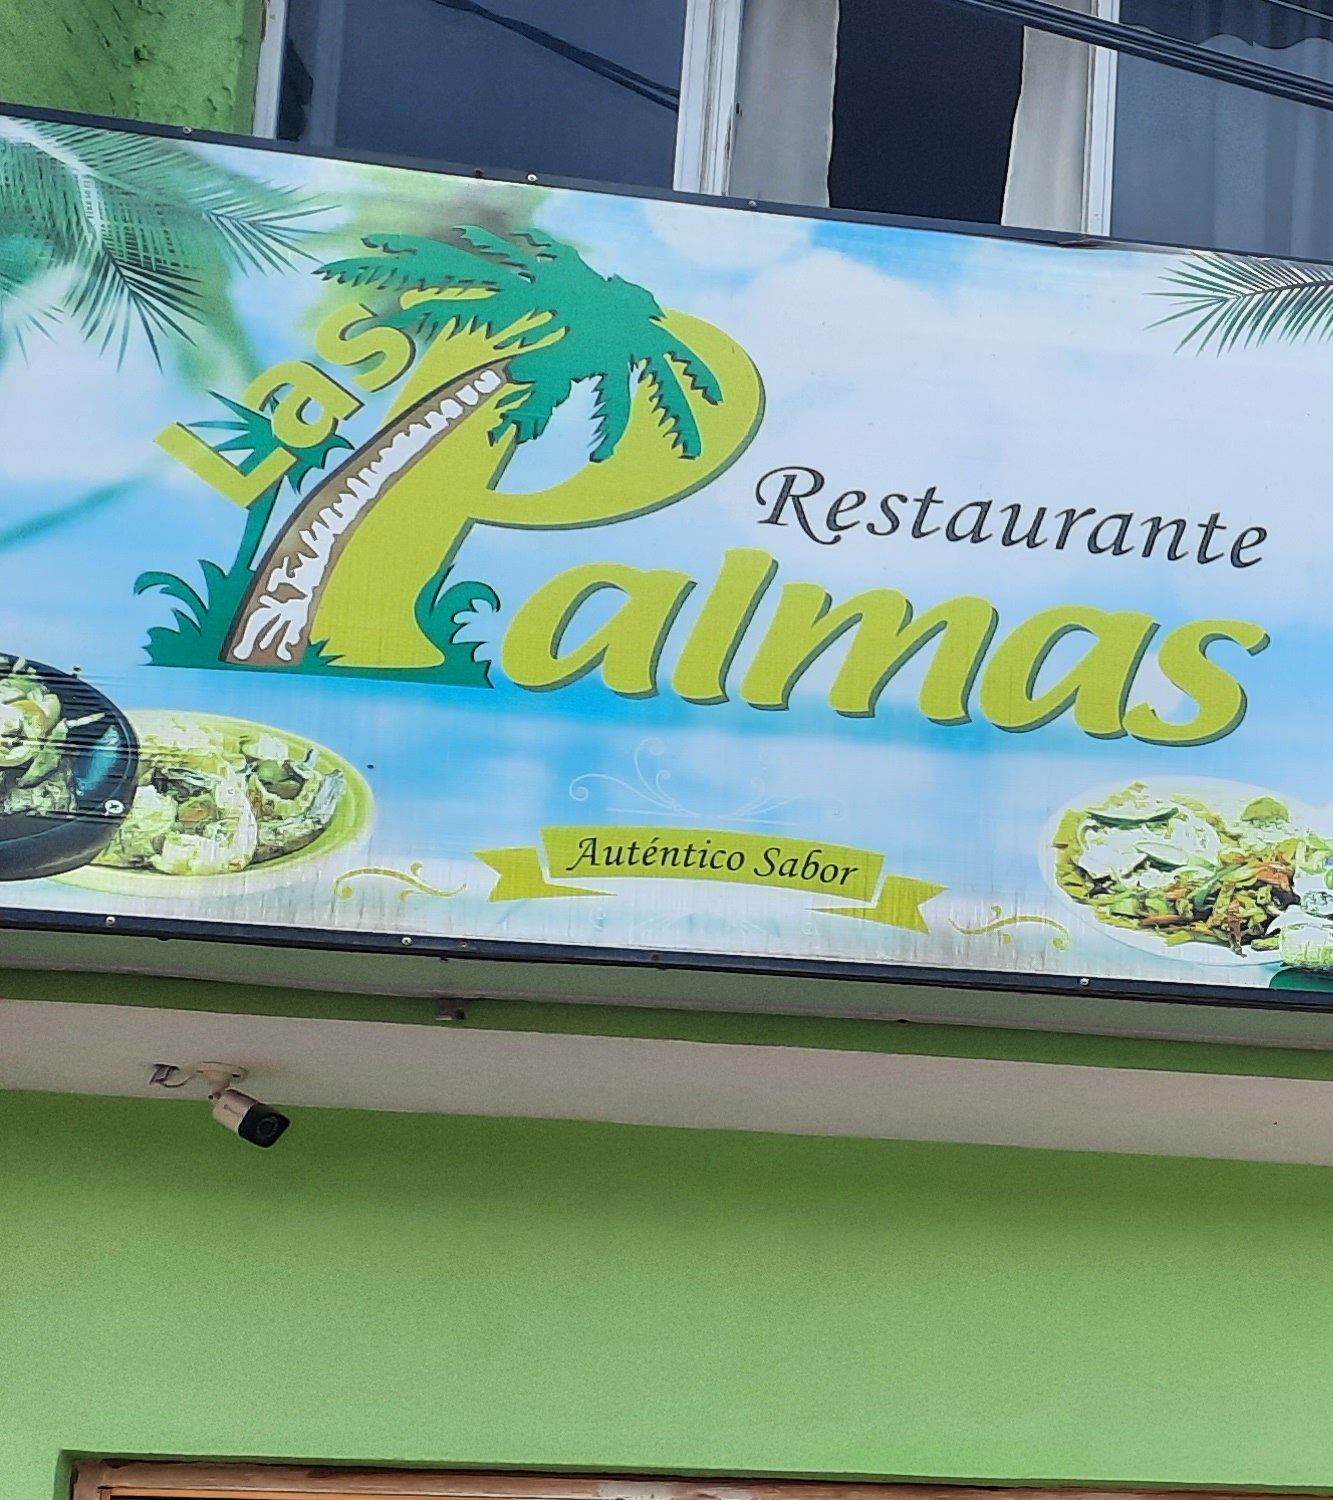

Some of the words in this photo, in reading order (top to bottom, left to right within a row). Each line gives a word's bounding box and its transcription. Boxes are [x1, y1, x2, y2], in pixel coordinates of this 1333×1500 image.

[153, 304, 417, 509] Las
[225, 283, 1270, 747] Palmas
[755, 465, 1268, 569] Restaurante
[566, 835, 746, 878] Auténtico
[756, 843, 861, 888] Sabor
